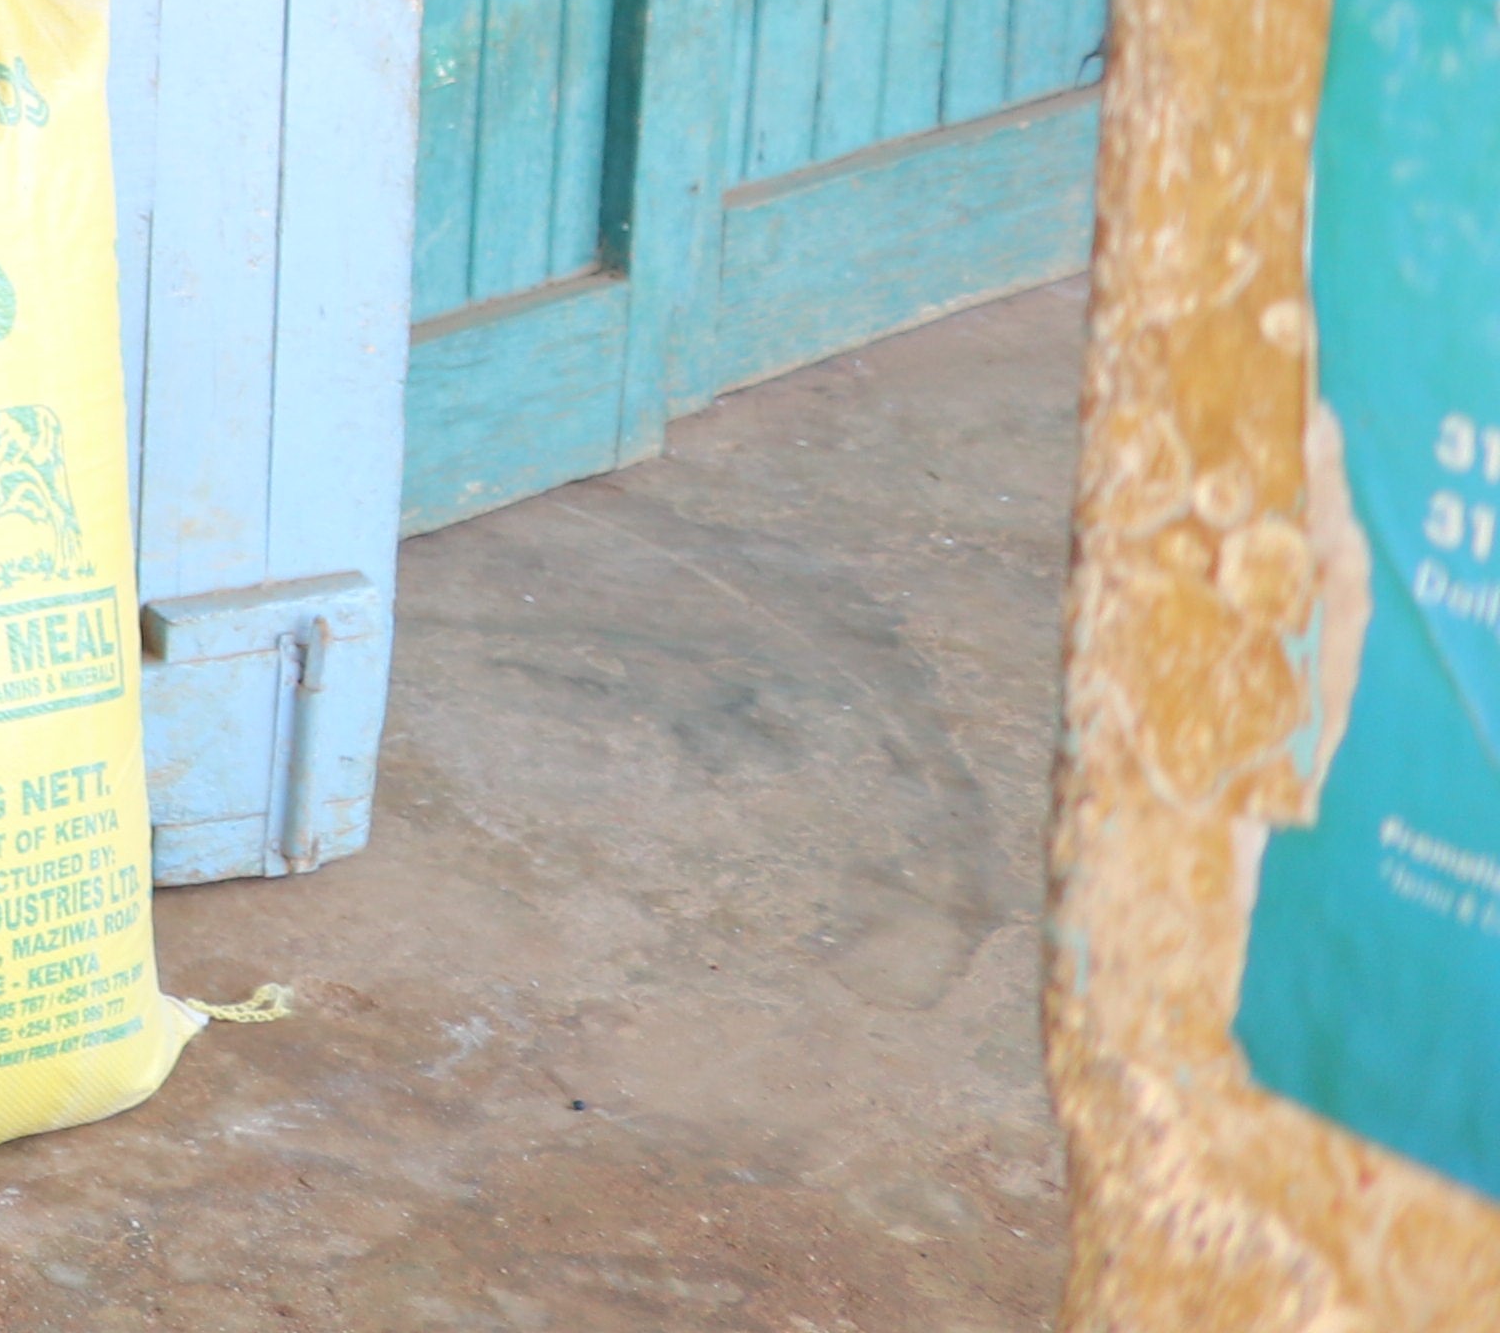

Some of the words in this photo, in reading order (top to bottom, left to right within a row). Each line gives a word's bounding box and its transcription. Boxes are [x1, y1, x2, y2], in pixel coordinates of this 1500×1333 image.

[5, 606, 116, 675] MEAL
[20, 761, 112, 816] NETT.
[14, 825, 47, 854] OF
[54, 808, 120, 845] KENYA
[88, 844, 116, 871] BY:
[11, 919, 98, 961] MAZIWA
[103, 901, 141, 935] ROAD
[27, 953, 100, 990] KENYA
[18, 1016, 52, 1038] +254
